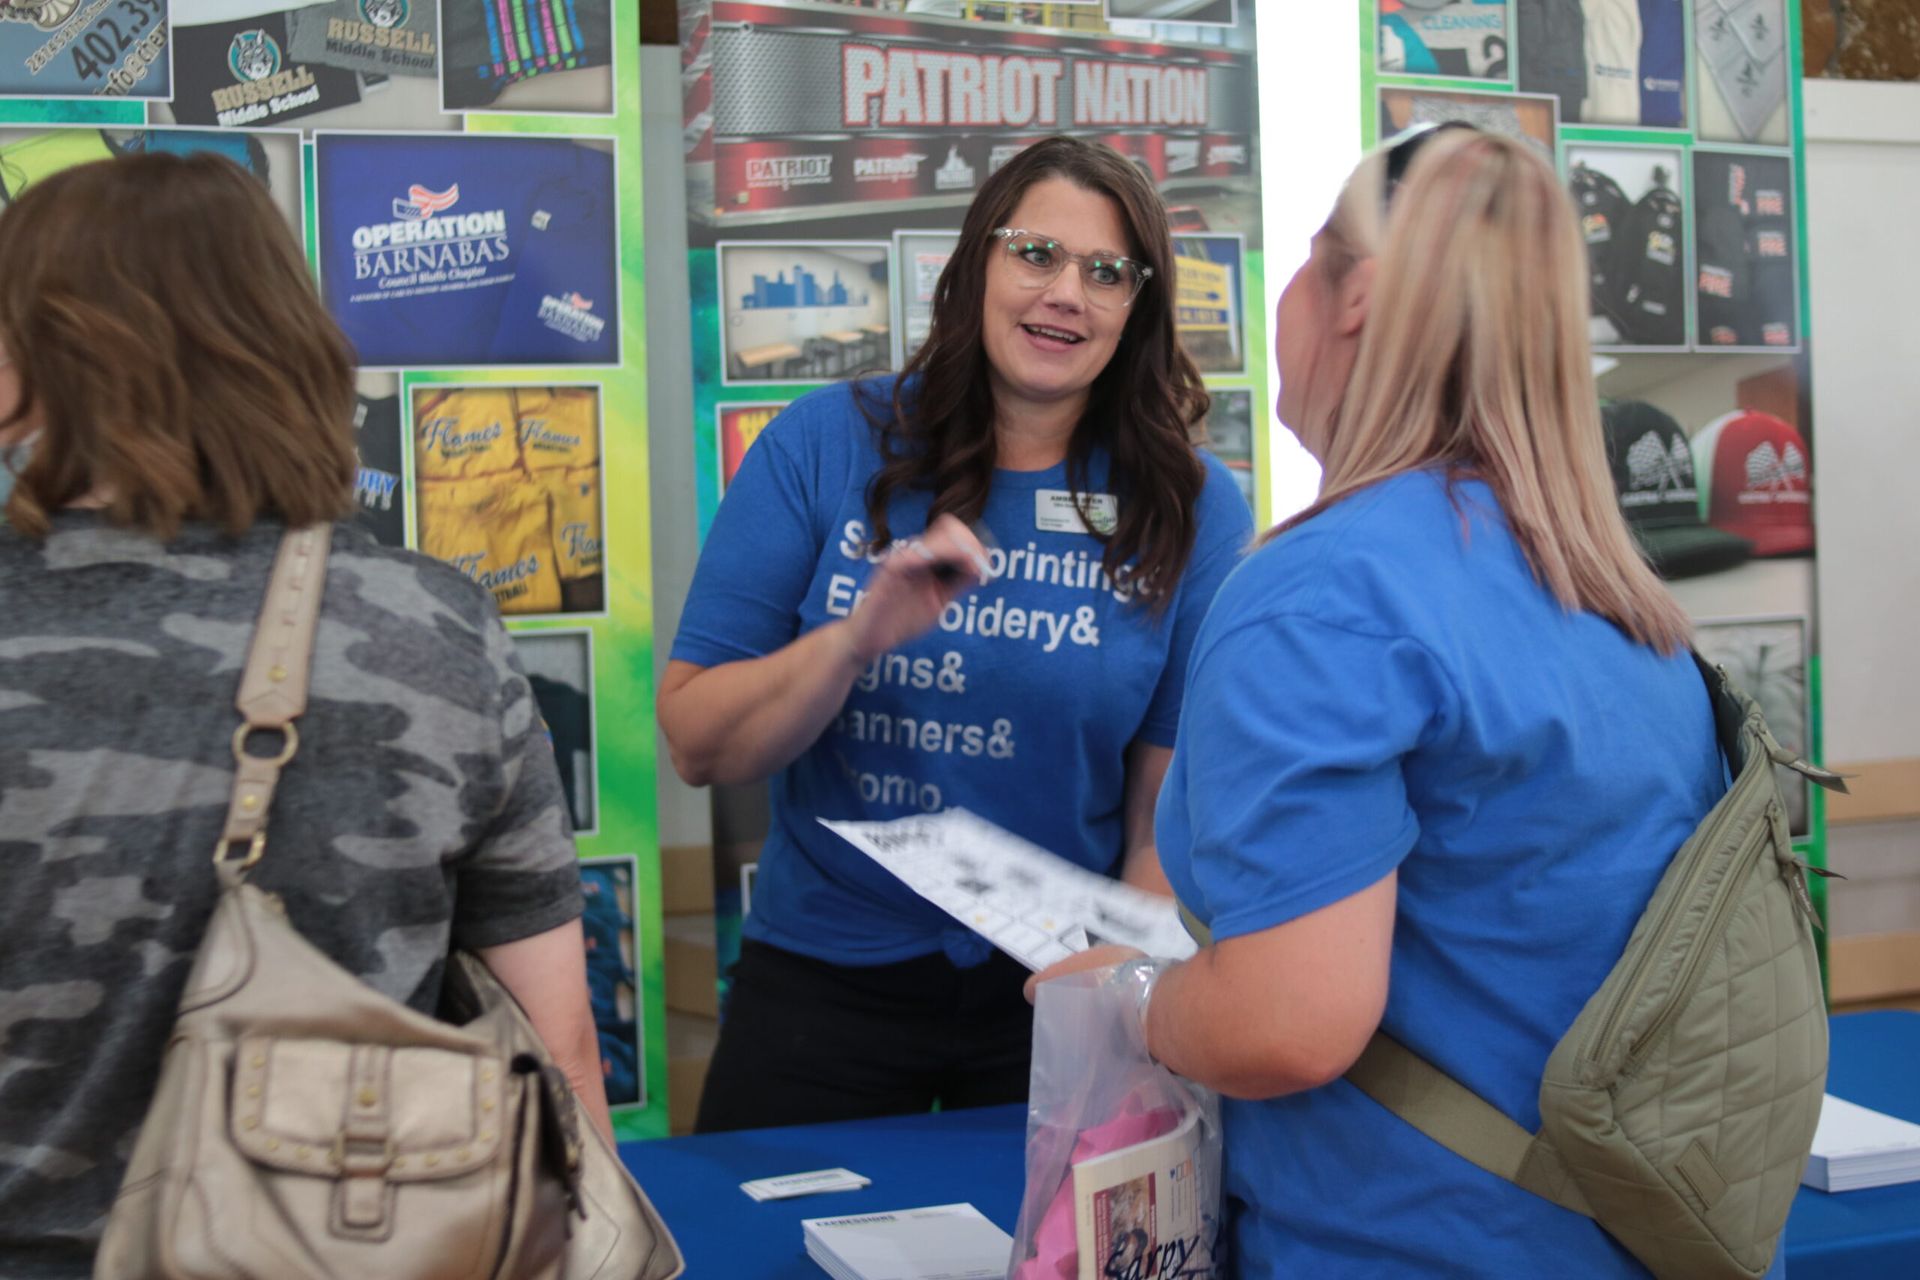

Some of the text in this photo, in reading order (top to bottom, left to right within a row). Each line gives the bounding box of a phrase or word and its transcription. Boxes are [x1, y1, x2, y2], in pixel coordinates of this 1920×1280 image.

[325, 40, 435, 69] Middle School
[326, 17, 436, 54] RUSSELL
[211, 65, 315, 112] RUSSELL
[842, 43, 1206, 126] PATRIOT NATION
[216, 85, 320, 127] Middle School
[748, 157, 828, 177] PATRIOT
[351, 209, 507, 250] OPERATION
[354, 234, 511, 280] BARNABAS
[856, 651, 967, 694] gns&
[838, 710, 1016, 759] anners&
